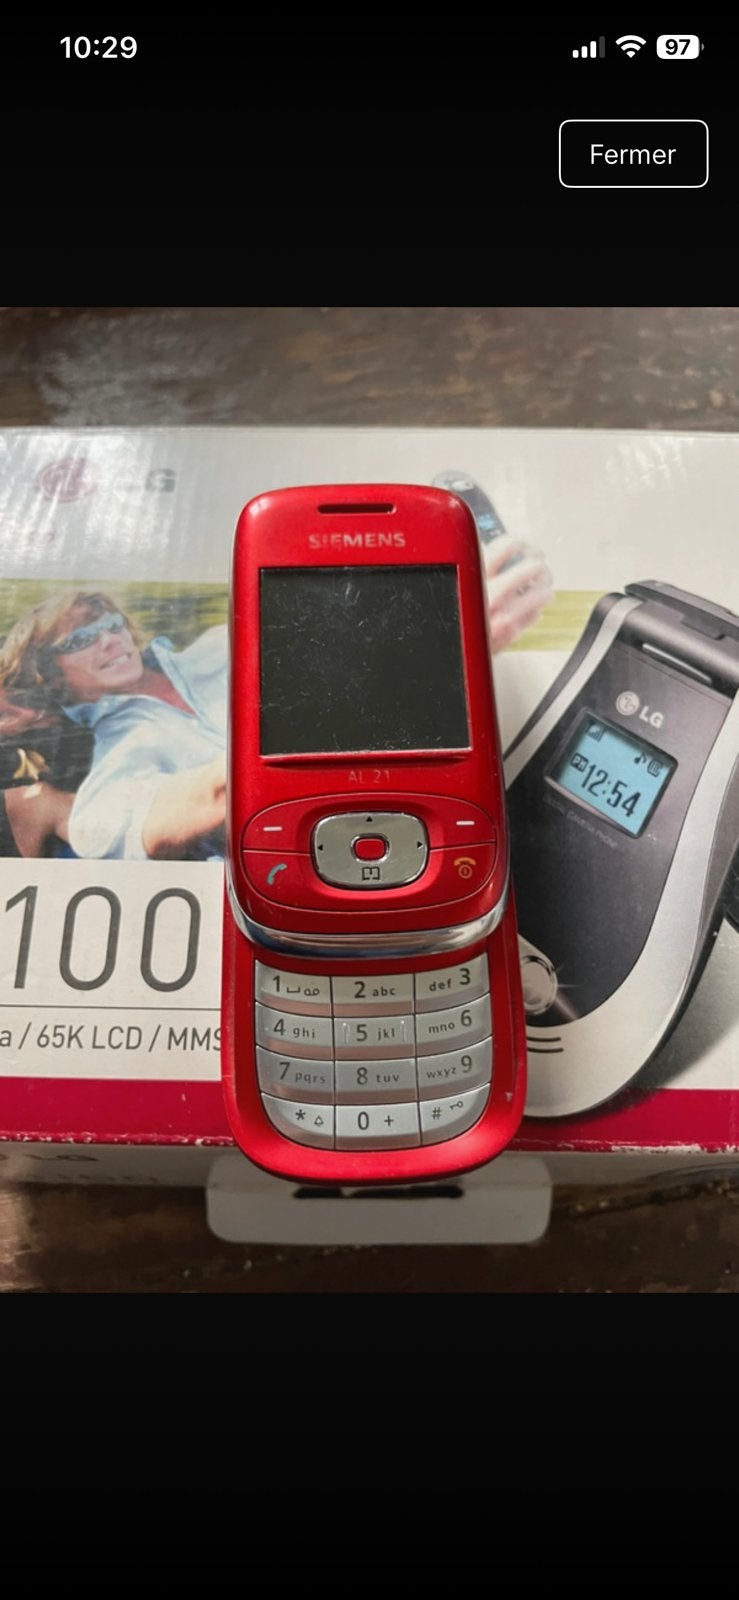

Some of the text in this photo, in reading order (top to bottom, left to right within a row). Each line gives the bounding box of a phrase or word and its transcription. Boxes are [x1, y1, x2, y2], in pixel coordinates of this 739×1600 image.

[639, 705, 664, 728] LG
[348, 769, 390, 784] AL 21
[581, 764, 642, 817] 12:54
[5, 885, 202, 992] 100
[273, 976, 281, 992] 1
[354, 981, 397, 998] 2 abc
[429, 968, 471, 992] def 3
[273, 1019, 316, 1039] 4 ghi
[428, 1009, 473, 1034] mno 6
[0, 1030, 11, 1047] a
[37, 1024, 84, 1048] 65K
[92, 1026, 142, 1050] LCD
[356, 1024, 396, 1042] 5 jkl
[279, 1062, 326, 1084] 7 pqrs
[356, 1067, 399, 1085] 8 tuv
[426, 1055, 473, 1079] wxyz 9
[357, 1111, 370, 1131] 0
